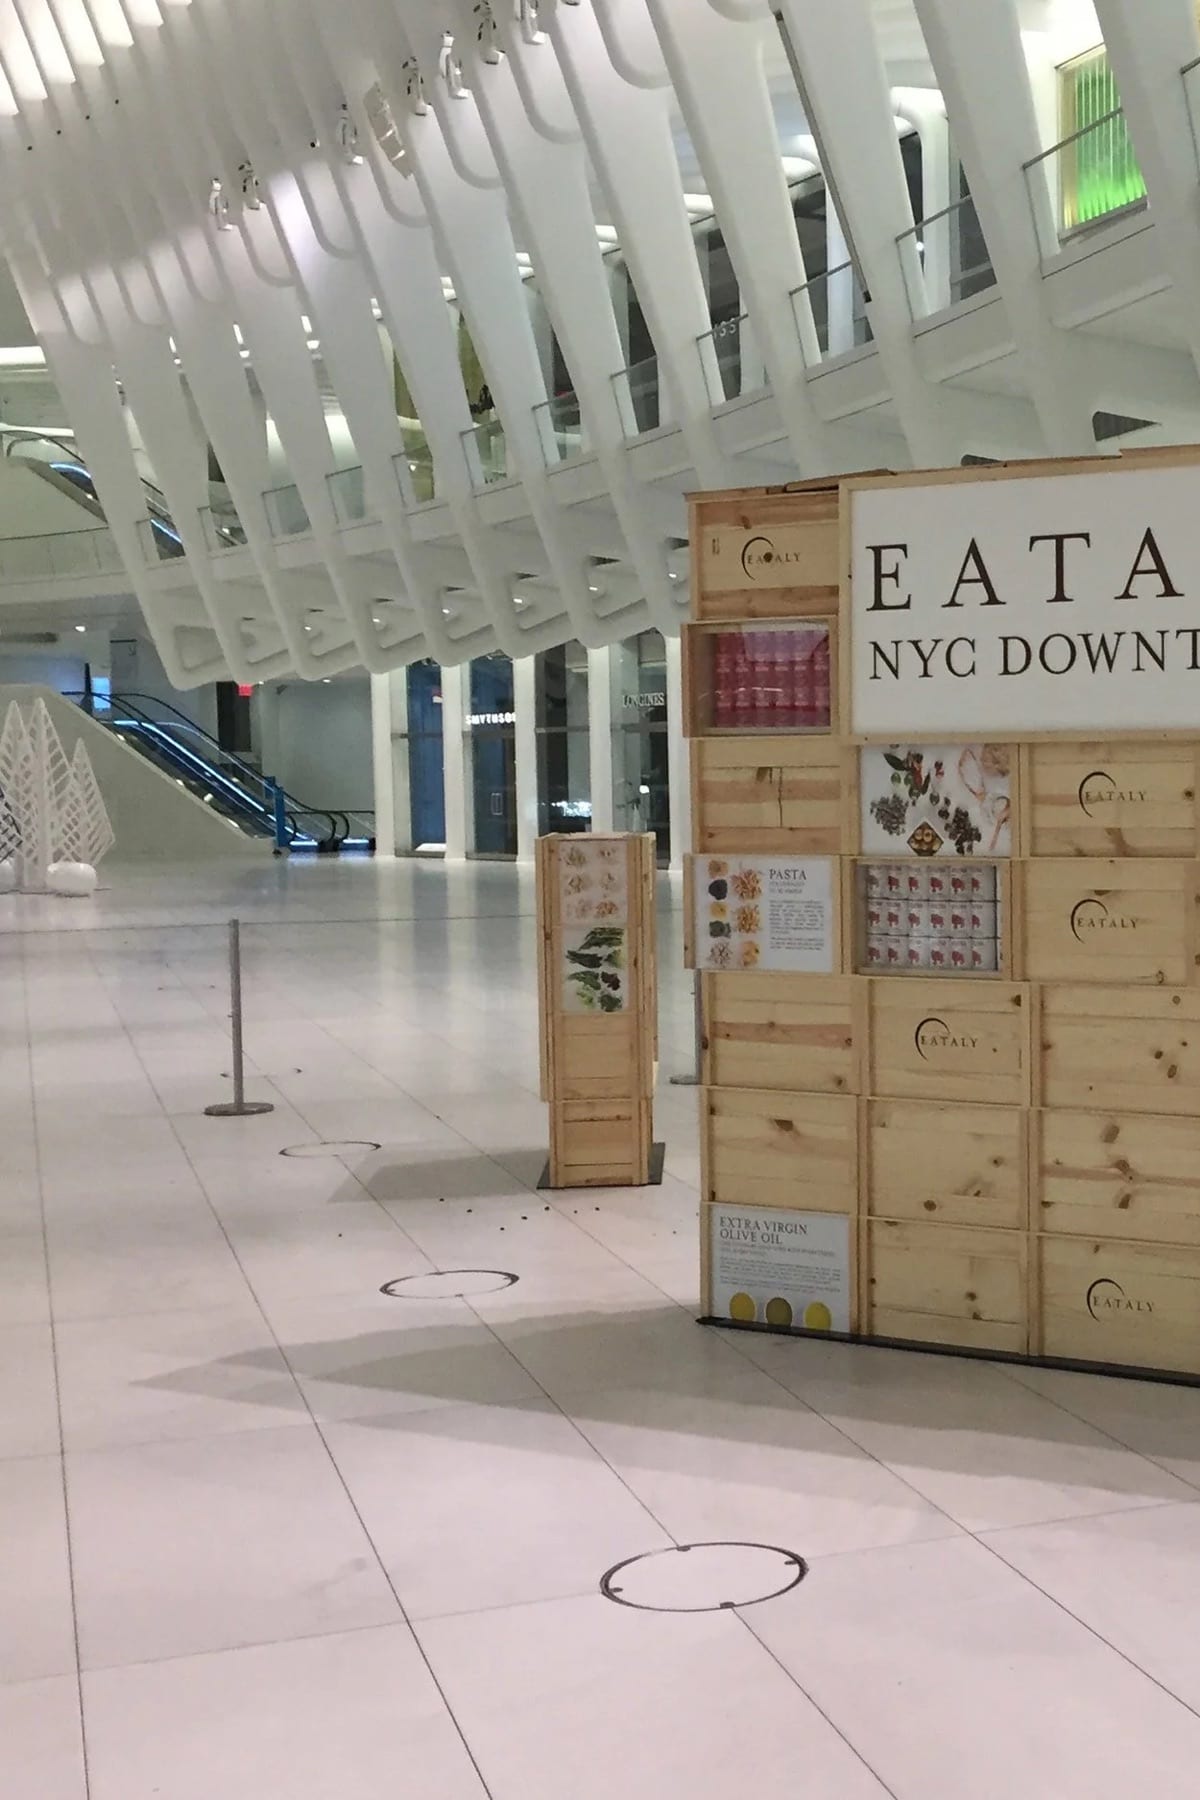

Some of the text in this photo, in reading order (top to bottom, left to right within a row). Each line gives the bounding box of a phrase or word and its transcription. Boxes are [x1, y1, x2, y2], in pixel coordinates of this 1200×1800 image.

[746, 551, 800, 565] EAALY
[868, 636, 978, 681] NYC
[622, 692, 665, 708] LONGINES
[1085, 790, 1147, 801] EATALY
[769, 868, 807, 881] PASTA
[1077, 917, 1138, 929] EATALY
[920, 1035, 978, 1048] EATALY
[719, 1216, 808, 1235] EXTRA VIRGIN
[719, 1228, 783, 1245] OLIVE OIL
[1093, 1295, 1155, 1313] EATALY
